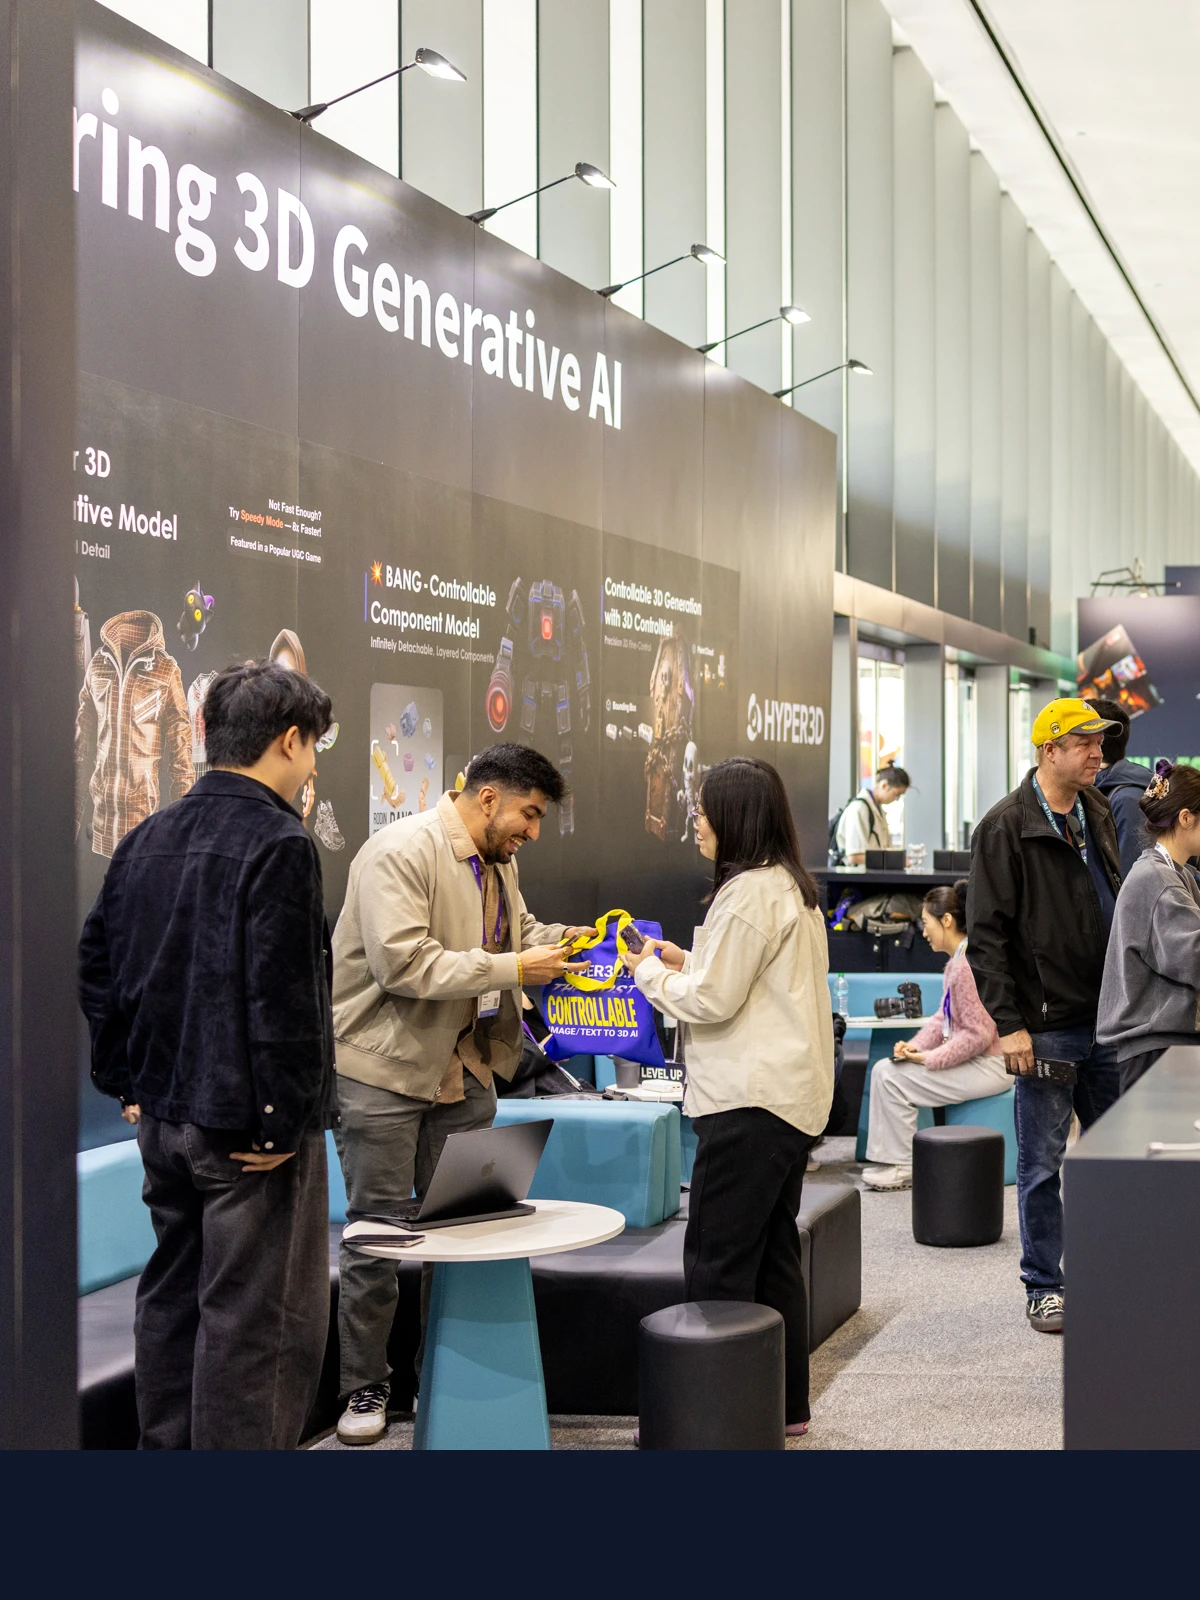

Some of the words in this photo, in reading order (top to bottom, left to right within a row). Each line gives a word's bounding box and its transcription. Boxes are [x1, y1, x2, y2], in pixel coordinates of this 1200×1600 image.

[235, 171, 316, 289] 3D
[332, 224, 582, 412] Generative
[588, 351, 623, 430] AI
[84, 446, 111, 478] 3D
[73, 494, 113, 528] tive
[118, 503, 178, 541] Model
[228, 506, 240, 521] Try
[240, 509, 265, 527] Speedy
[265, 515, 284, 529] Mode
[300, 523, 322, 538] Faster!
[268, 498, 281, 512] Not
[281, 502, 295, 515] Fast
[295, 505, 322, 522] Enough?
[81, 540, 111, 560] Detail
[230, 535, 257, 551] Featured
[257, 541, 264, 551] in
[264, 545, 269, 553] a
[269, 543, 291, 557] Popular
[291, 548, 305, 561] UGC
[305, 551, 322, 564] Game
[385, 564, 422, 593] BANG
[429, 574, 497, 607] Controllable
[604, 576, 652, 605] Controllable
[652, 588, 664, 607] 3D
[664, 591, 703, 617] Generation
[370, 600, 443, 633] Component
[444, 613, 480, 639] Model
[604, 608, 621, 628] with
[622, 610, 633, 630] 3D
[634, 613, 674, 638] ControlNet
[370, 635, 397, 654] Infinitely
[398, 639, 435, 657] Detachable,
[436, 645, 460, 660] Layered
[460, 648, 495, 664] Components
[763, 698, 825, 746] HYPER3D
[547, 994, 638, 1028] CONTROLLABLE
[603, 1028, 616, 1037] TO
[617, 1029, 629, 1038] 3D
[629, 1029, 639, 1038] AI
[640, 1066, 669, 1080] LEVEL
[670, 1068, 684, 1081] UP
